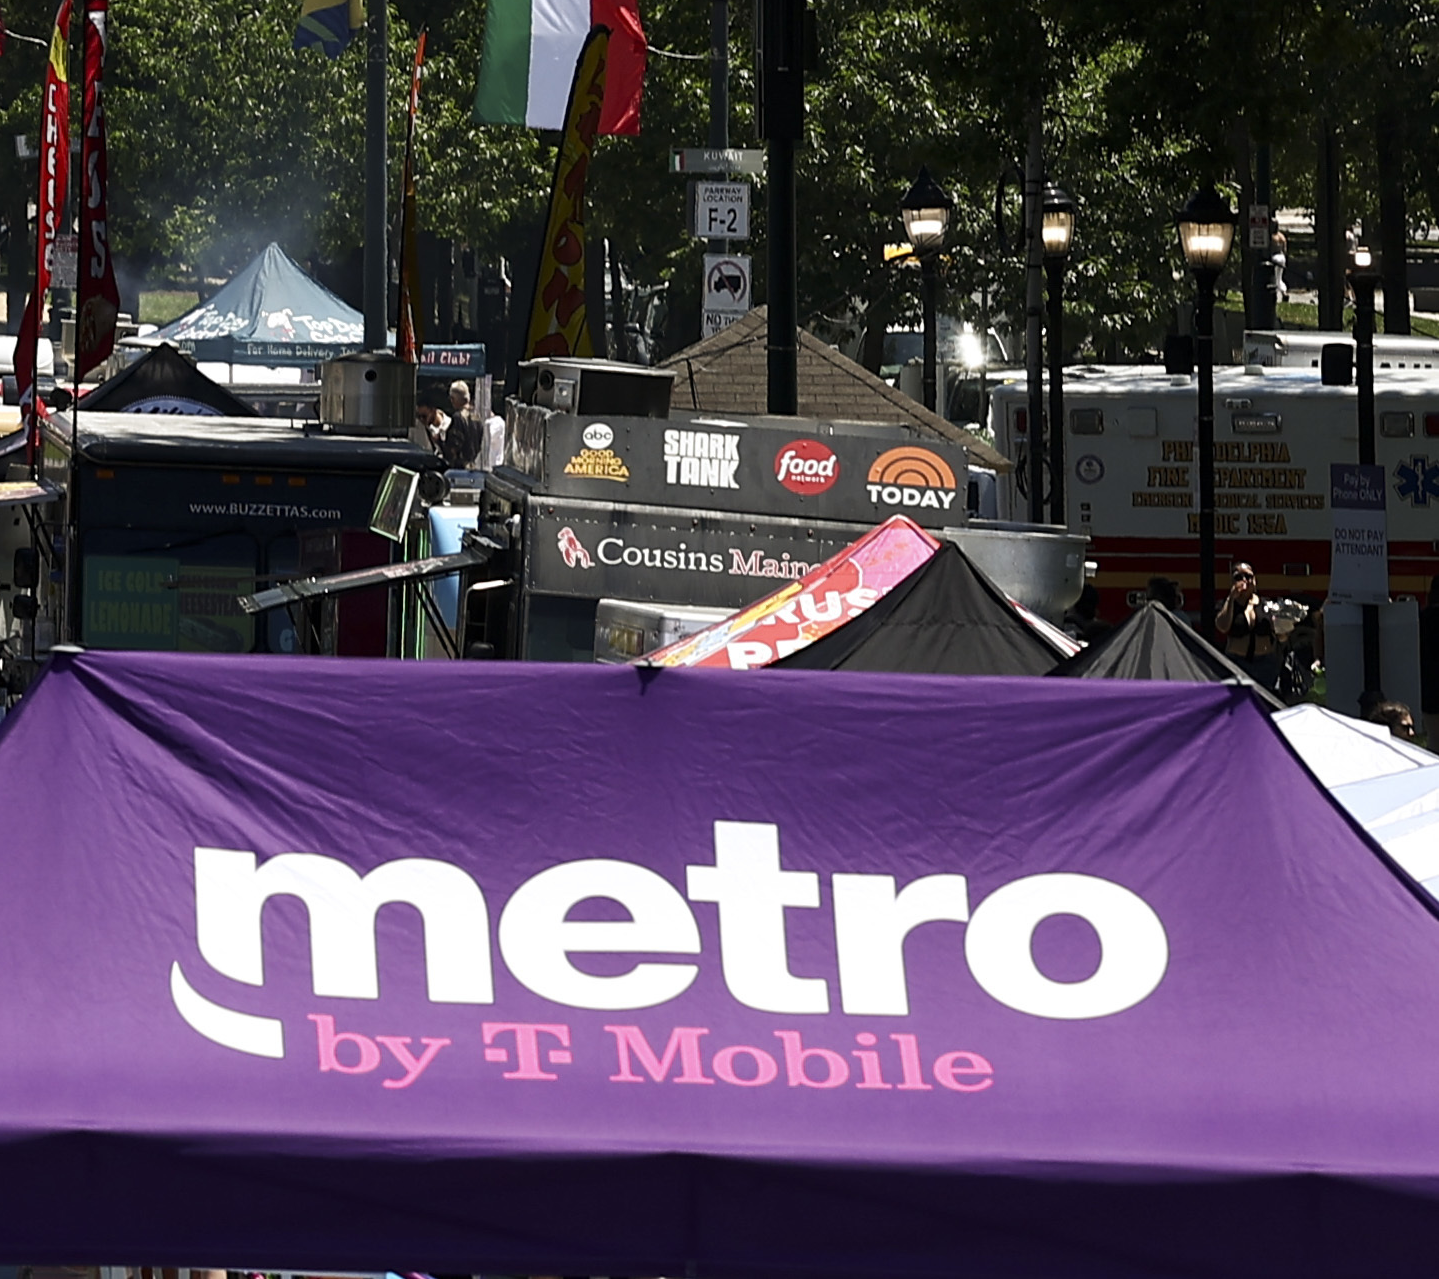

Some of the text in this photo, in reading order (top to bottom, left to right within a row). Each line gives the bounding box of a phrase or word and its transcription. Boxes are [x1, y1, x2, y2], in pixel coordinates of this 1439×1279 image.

[703, 151, 744, 161] KUWAIT
[702, 195, 744, 203] LOCATION
[704, 187, 743, 195] PARKWAY
[708, 207, 738, 233] F-2
[705, 314, 722, 326] NO
[296, 345, 335, 360] Delivery
[439, 352, 470, 367] Club!
[584, 428, 612, 442] abc
[663, 428, 741, 460] SHARK
[1161, 440, 1292, 464] PHIDELPHIA
[570, 455, 623, 466] MORNING
[580, 448, 614, 459] GOOD
[563, 462, 630, 479] AMERICA
[663, 454, 741, 490] TANK
[775, 449, 839, 483] food
[790, 473, 826, 484] network
[1147, 465, 1308, 490] FIRE EPARTMENT
[1343, 473, 1371, 488] Pay by
[865, 483, 957, 511] TODAY
[1132, 491, 1326, 510] EMERGEN EDICAL SERVICES
[1332, 485, 1383, 502] Phone ONLY
[188, 502, 342, 520] www.BUZZETTAS.com
[1187, 512, 1241, 535] MDIC
[1334, 527, 1385, 543] DO NOT PAY
[596, 537, 724, 573] Cousins
[1334, 542, 1385, 557] ATTENDANT
[98, 569, 115, 591] ICE
[89, 600, 173, 635] LEMONADE
[171, 820, 1169, 1058] metro
[306, 1012, 452, 1089] by
[603, 1024, 995, 1093] Mobile
